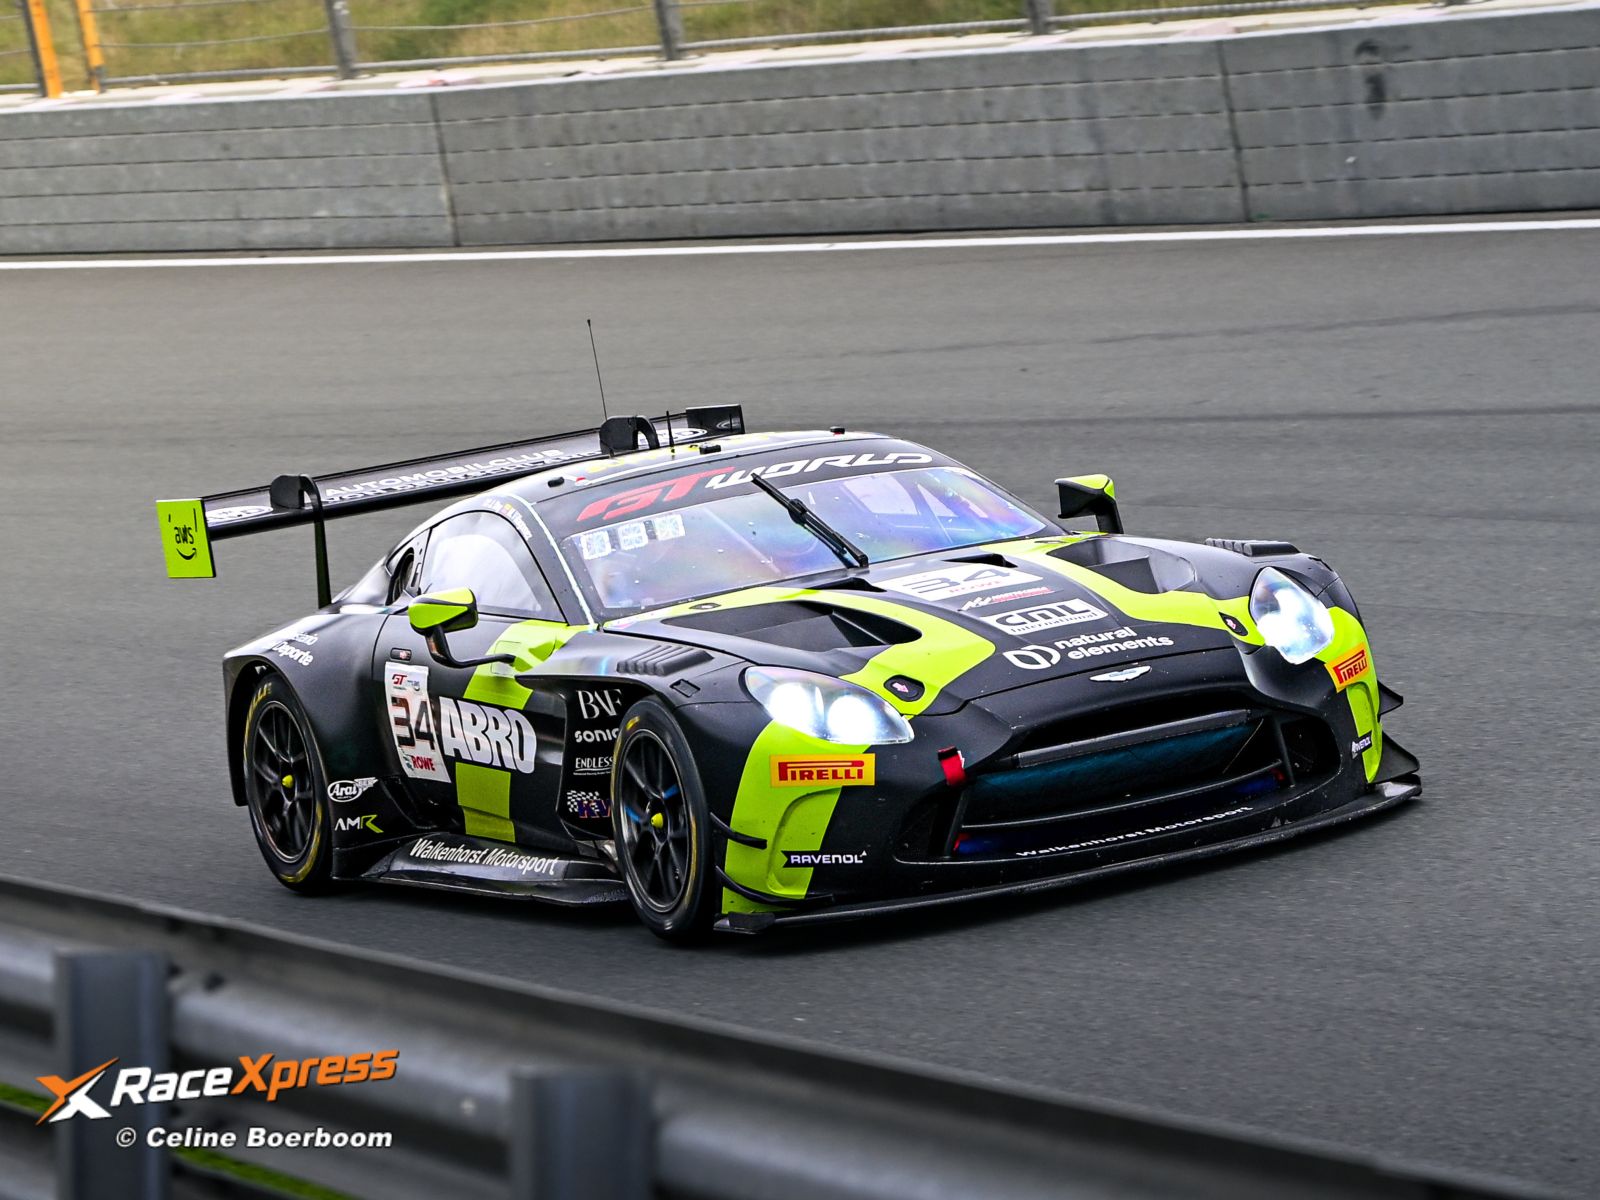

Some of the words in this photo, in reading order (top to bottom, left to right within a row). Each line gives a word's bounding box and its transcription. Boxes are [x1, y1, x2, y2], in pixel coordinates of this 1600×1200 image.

[325, 449, 565, 497] AUTOMOBILCLUB
[576, 466, 735, 522] GT
[704, 452, 933, 489] WORLD
[174, 524, 195, 545] aws
[902, 568, 1011, 594] 34
[1009, 612, 1099, 633] International
[1054, 626, 1138, 650] natural
[1067, 635, 1175, 661] elements
[1333, 649, 1368, 685] PIRELLI
[390, 695, 436, 751] 34
[438, 695, 537, 775] ABRO
[411, 755, 436, 772] ROWE
[777, 760, 865, 782] PIRELLI
[330, 783, 358, 797] Arai
[334, 814, 384, 834] AMR
[1016, 830, 1147, 857] Walkenhorst
[1144, 805, 1254, 833] Motorsport
[409, 837, 486, 864] Walkenhorst
[483, 847, 560, 876] Motorsport
[790, 854, 864, 865] RAVENOL
